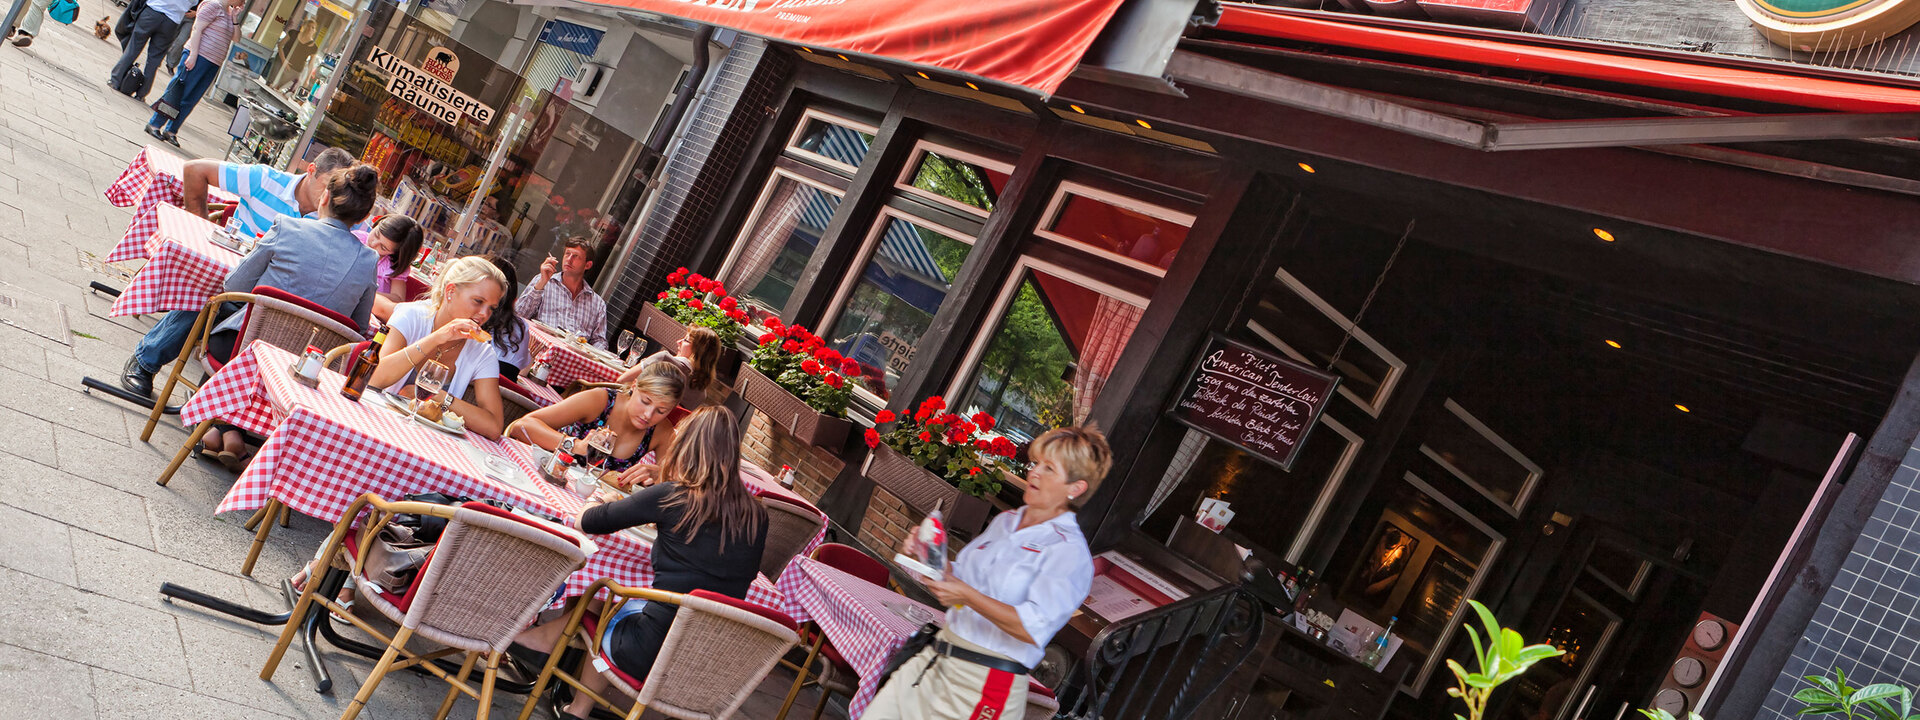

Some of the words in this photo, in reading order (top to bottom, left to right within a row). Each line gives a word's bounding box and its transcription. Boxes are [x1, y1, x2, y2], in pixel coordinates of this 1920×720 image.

[775, 11, 812, 23] PREMIUM
[423, 65, 453, 83] HOUSE
[426, 57, 455, 77] BLOCK
[370, 48, 489, 121] Klimatisierte
[390, 78, 457, 123] Räume
[1196, 373, 1224, 394] 250g
[1225, 381, 1238, 393] aus
[1206, 349, 1263, 382] American
[1265, 370, 1319, 404] Tenderloin
[1244, 418, 1271, 435] Block
[1273, 426, 1295, 446] House
